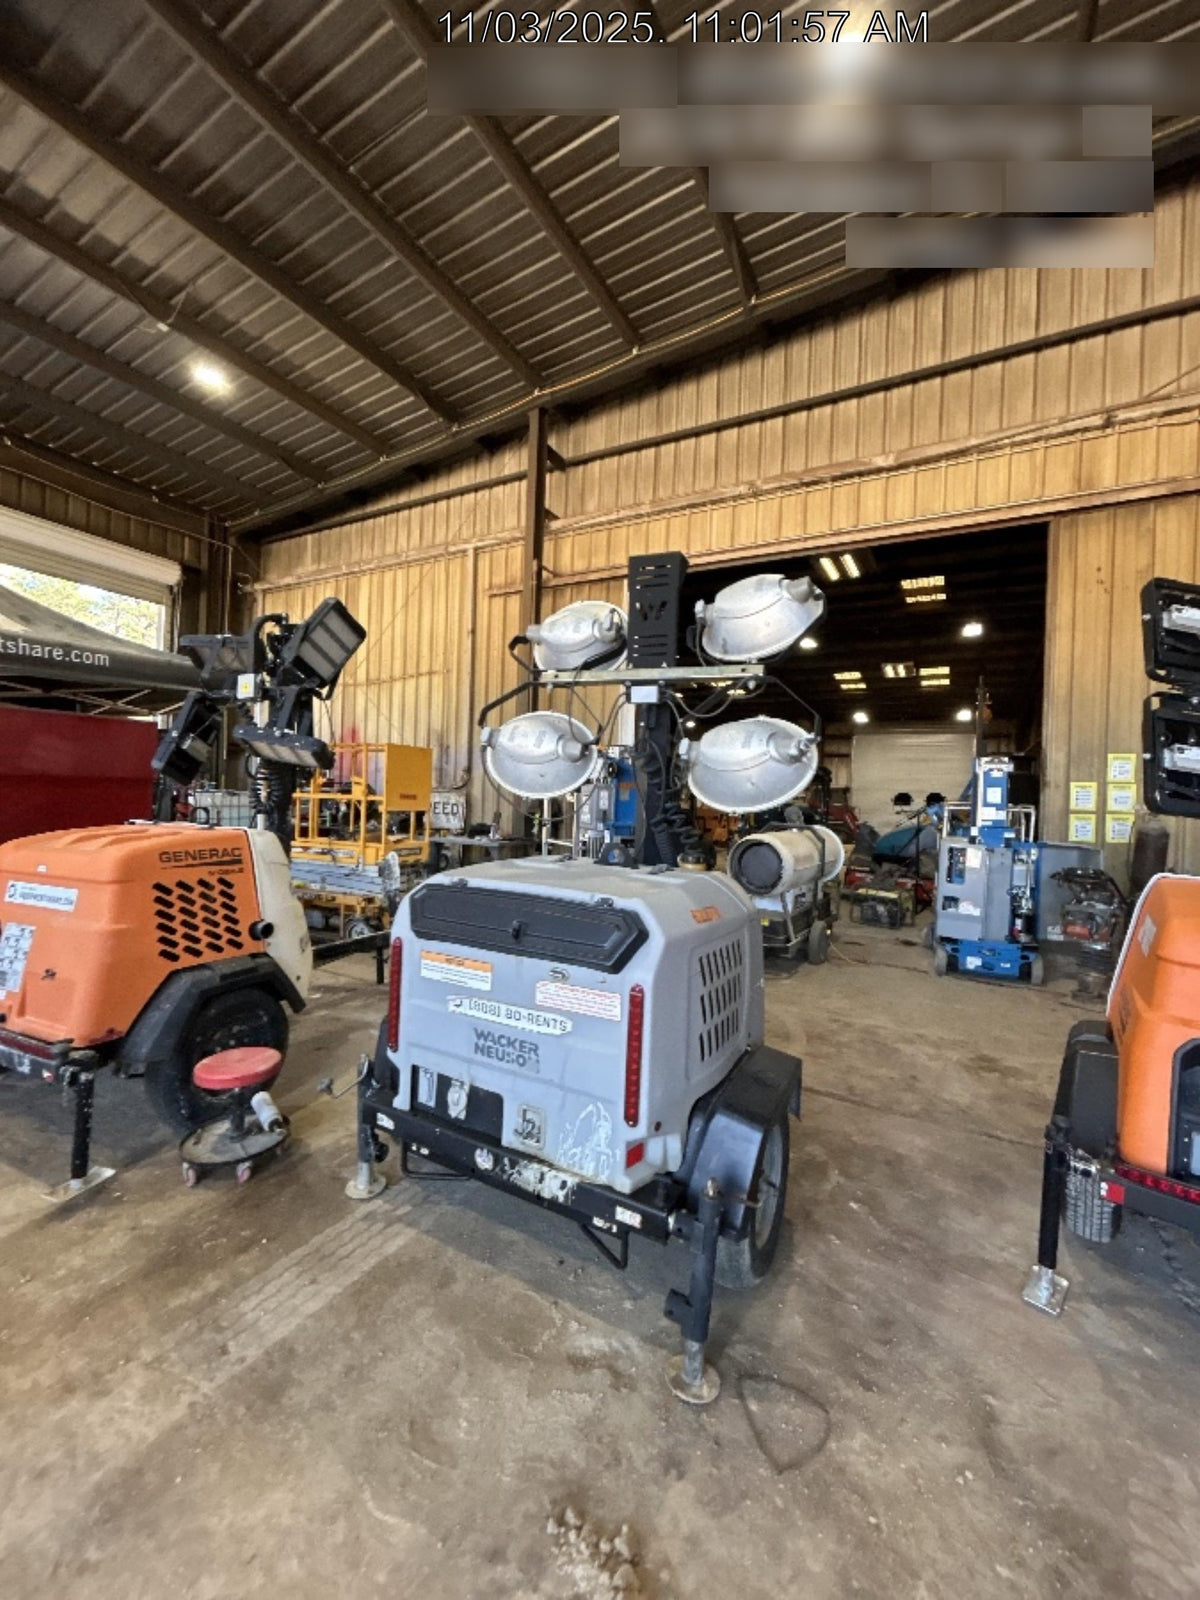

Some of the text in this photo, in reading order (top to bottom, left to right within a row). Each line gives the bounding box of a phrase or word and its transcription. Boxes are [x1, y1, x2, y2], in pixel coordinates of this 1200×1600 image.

[430, 801, 459, 816] EED
[159, 847, 242, 863] GENERAC
[474, 1027, 540, 1058] WACKER
